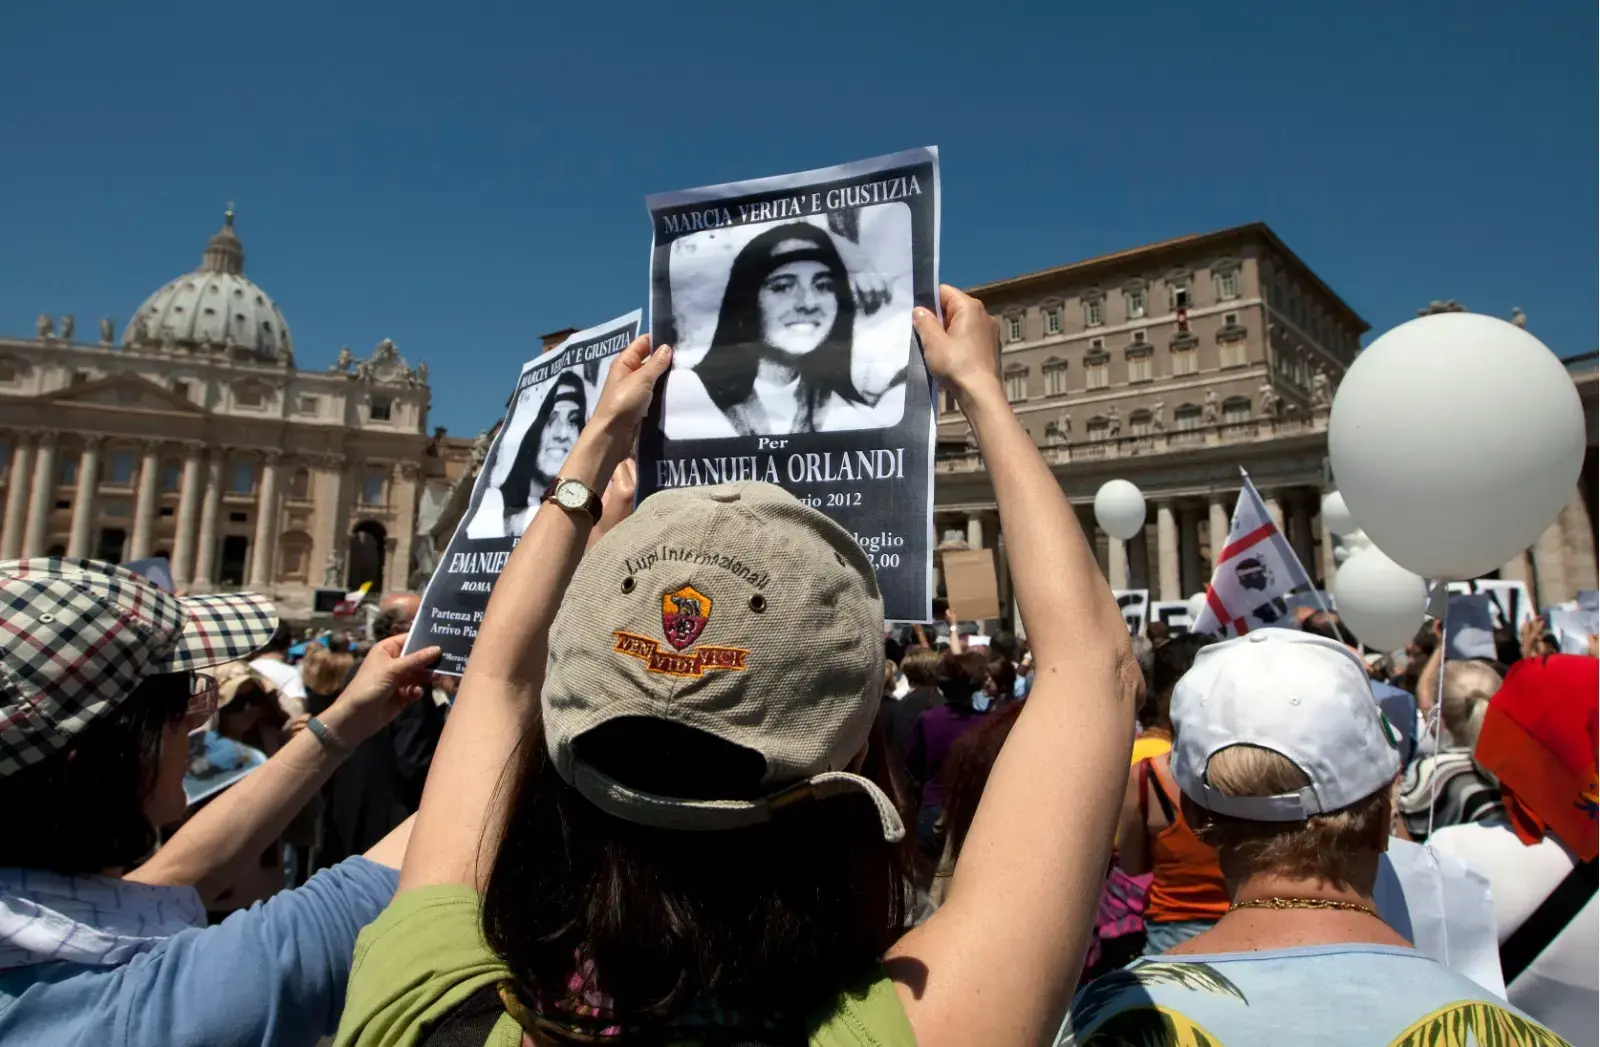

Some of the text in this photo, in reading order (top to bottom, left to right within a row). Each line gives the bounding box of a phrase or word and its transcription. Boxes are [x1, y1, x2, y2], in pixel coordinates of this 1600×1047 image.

[664, 174, 922, 234] MARCIA VERITA' E GIUSTIZIA
[521, 366, 549, 387] MARCIA
[575, 348, 583, 363] E
[585, 331, 631, 360] GIUSTIZIA
[758, 437, 789, 450] Per
[656, 448, 905, 488] EMANUELA ORLANDI
[826, 493, 862, 507] 2012
[624, 546, 771, 590] Lupi Internazionali
[461, 581, 491, 592] ROMA
[431, 607, 471, 622] Partenza
[430, 623, 477, 638] Arrivo Pia
[656, 656, 695, 673] VIDI
[701, 651, 737, 666] VICI
